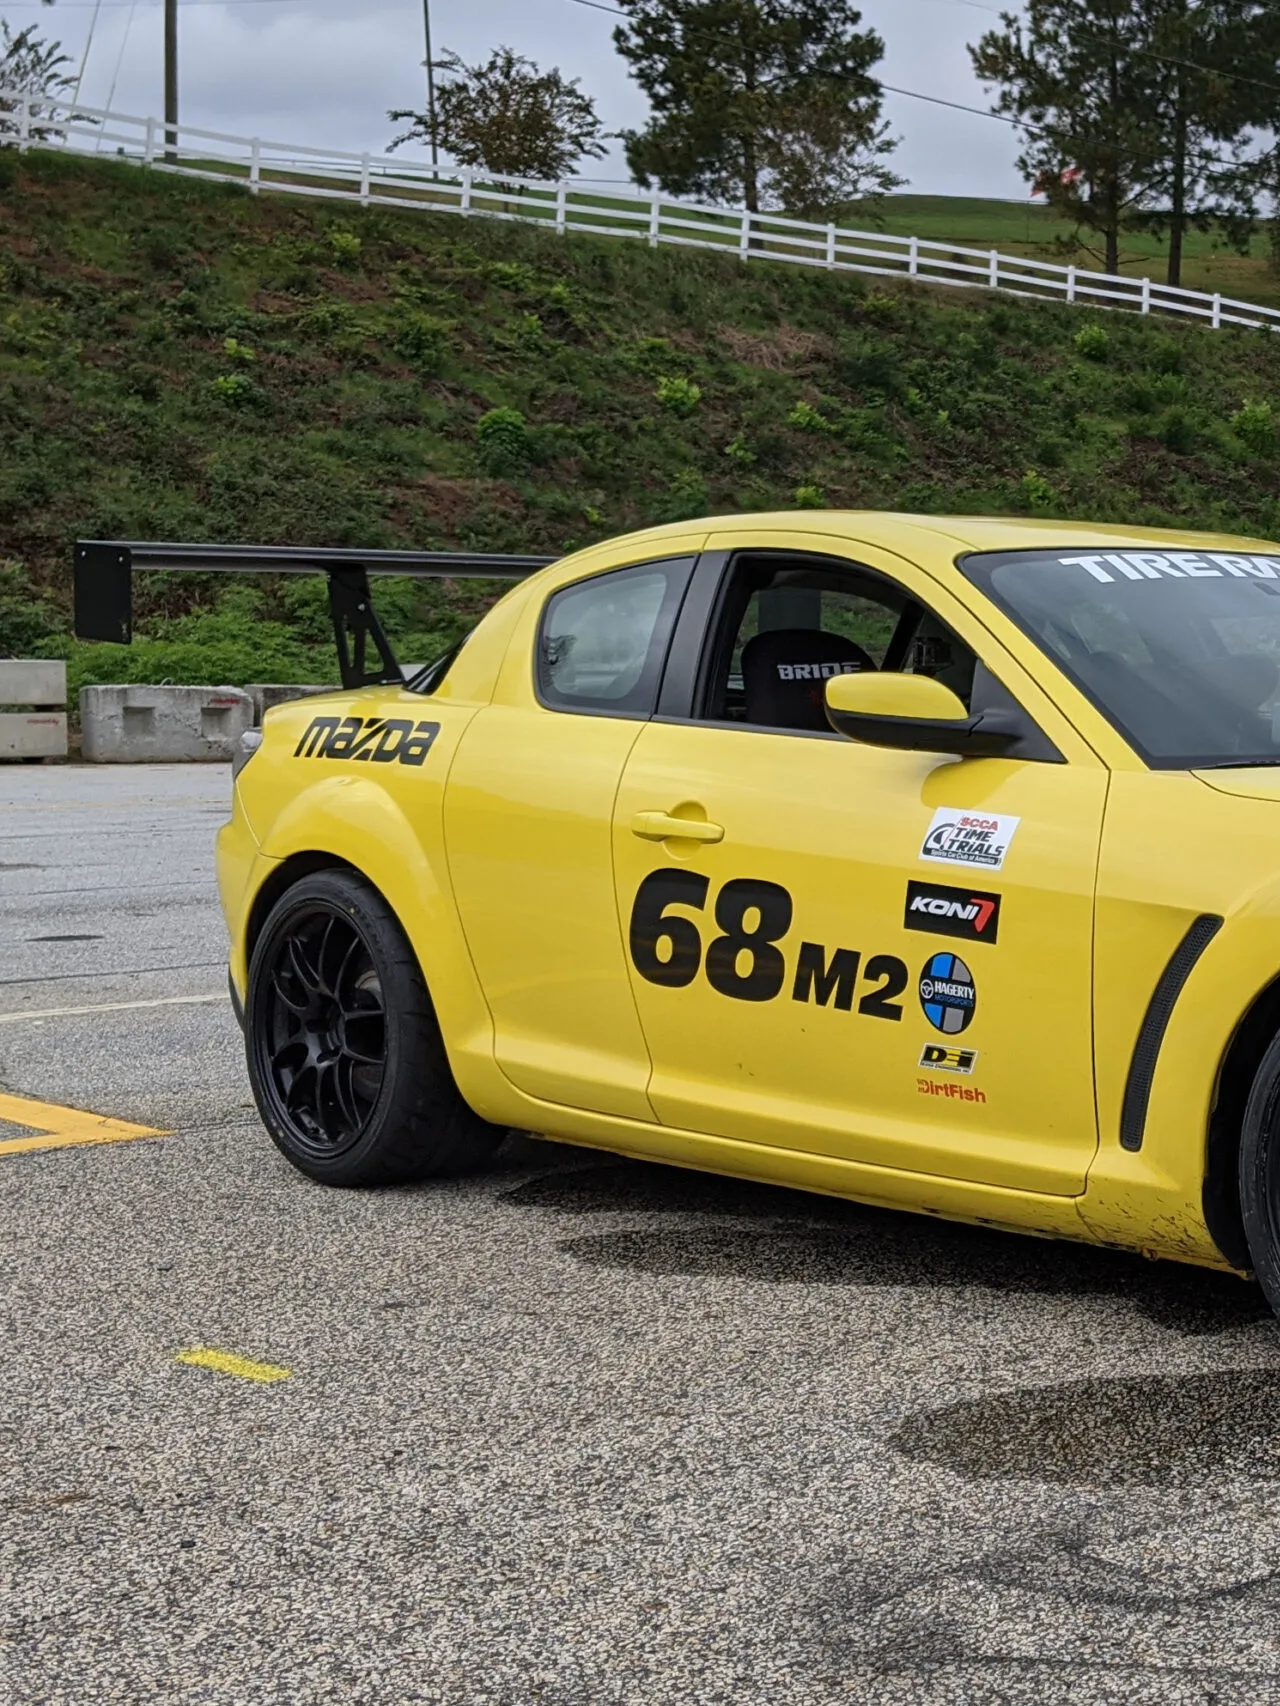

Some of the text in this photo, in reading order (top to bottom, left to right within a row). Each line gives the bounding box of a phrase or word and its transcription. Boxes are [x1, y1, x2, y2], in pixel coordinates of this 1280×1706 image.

[960, 816, 998, 831] SCCA
[910, 896, 979, 920] KONI
[629, 867, 909, 1022] 68 M2
[934, 981, 974, 999] HAGERTY
[916, 1078, 986, 1103] DirtFish
